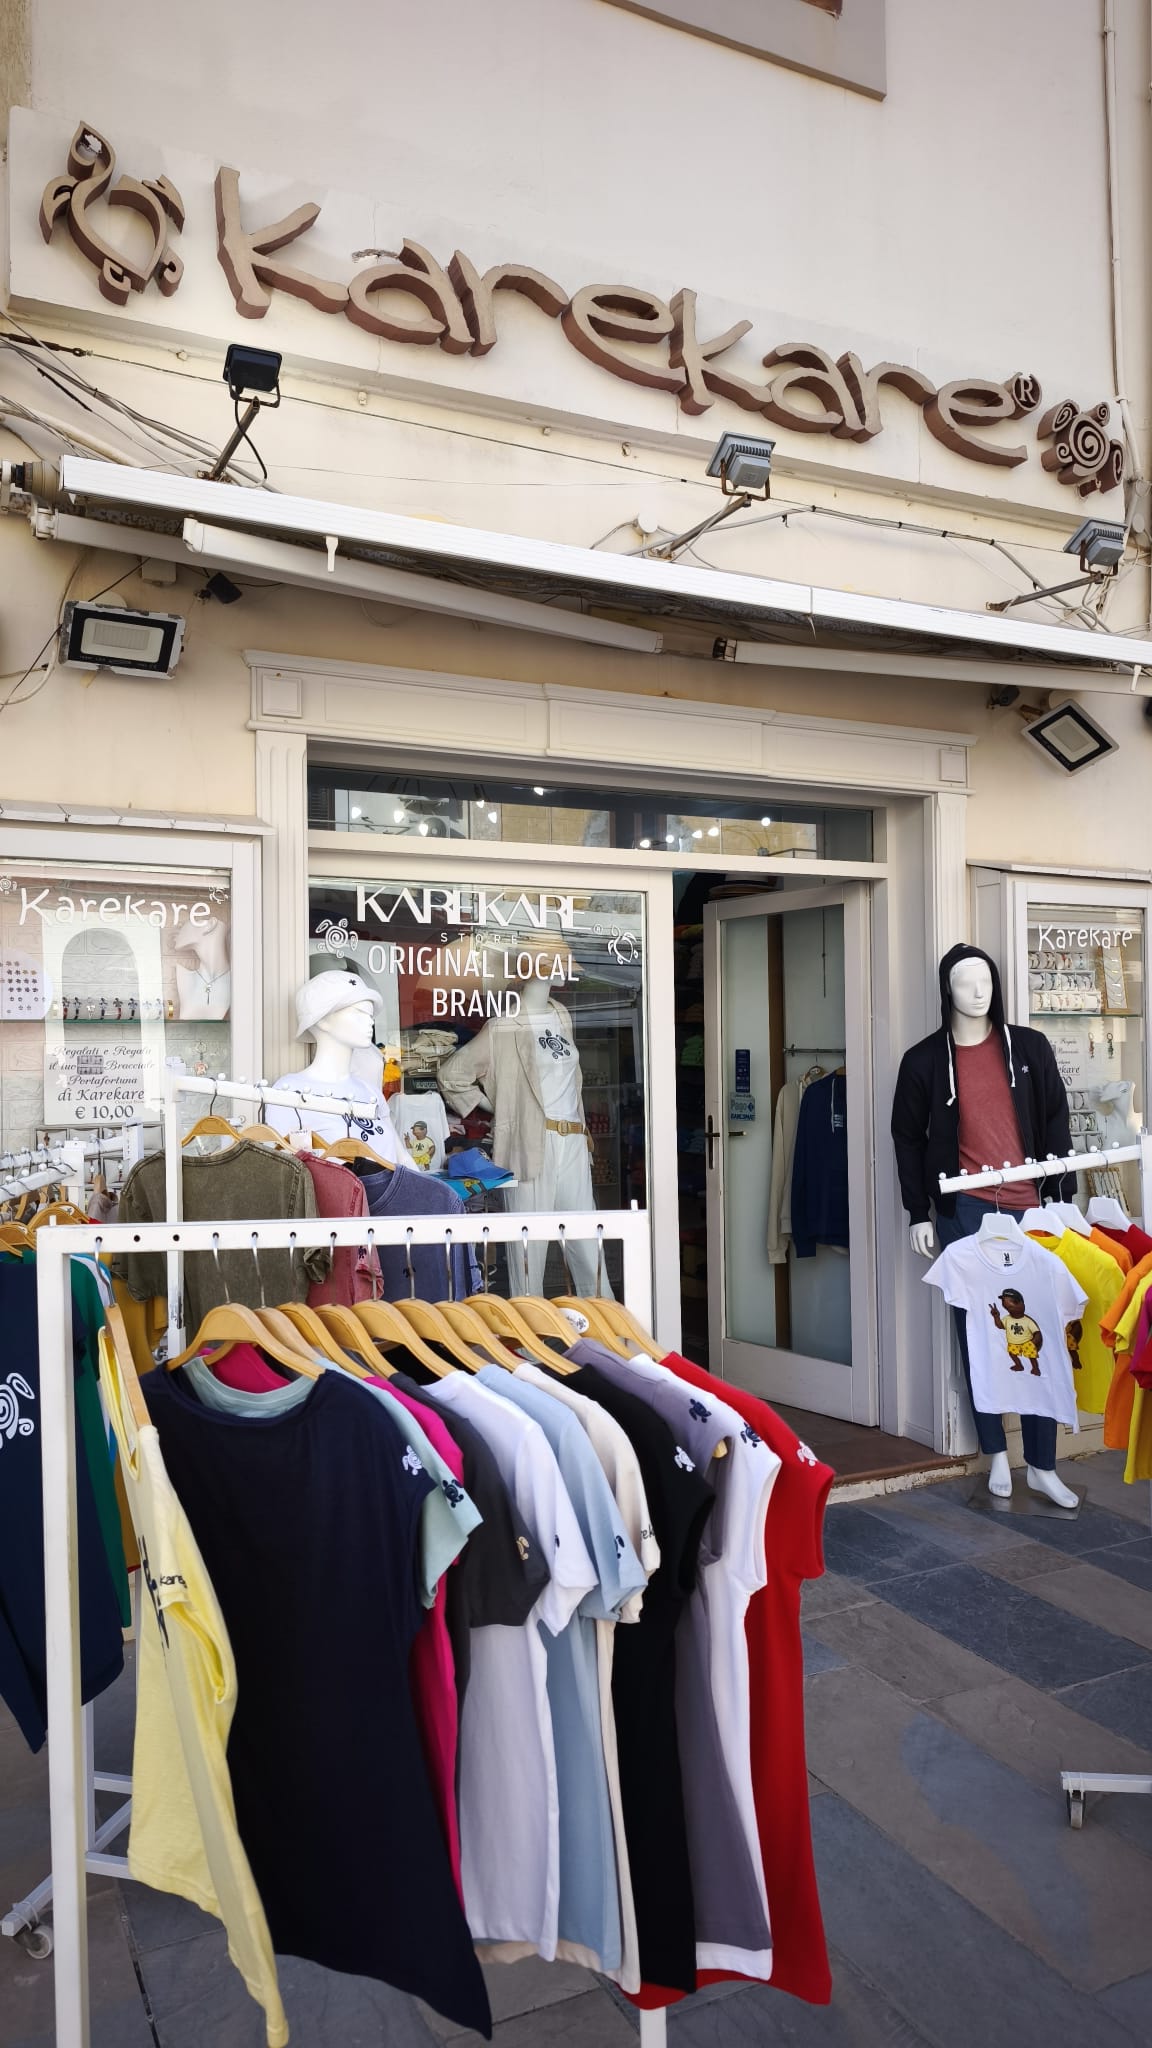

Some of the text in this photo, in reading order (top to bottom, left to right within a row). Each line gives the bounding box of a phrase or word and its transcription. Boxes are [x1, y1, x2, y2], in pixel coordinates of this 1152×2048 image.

[19, 887, 211, 929] Karekare
[440, 931, 518, 945] STORE
[1038, 924, 1133, 951] Karekare
[368, 945, 580, 982] ORIGINAL LOCAL
[432, 988, 522, 1018] BRAND
[68, 1075, 138, 1088] Portafortuna
[58, 1086, 145, 1101] di Karekare
[75, 1105, 134, 1120] € 10,00
